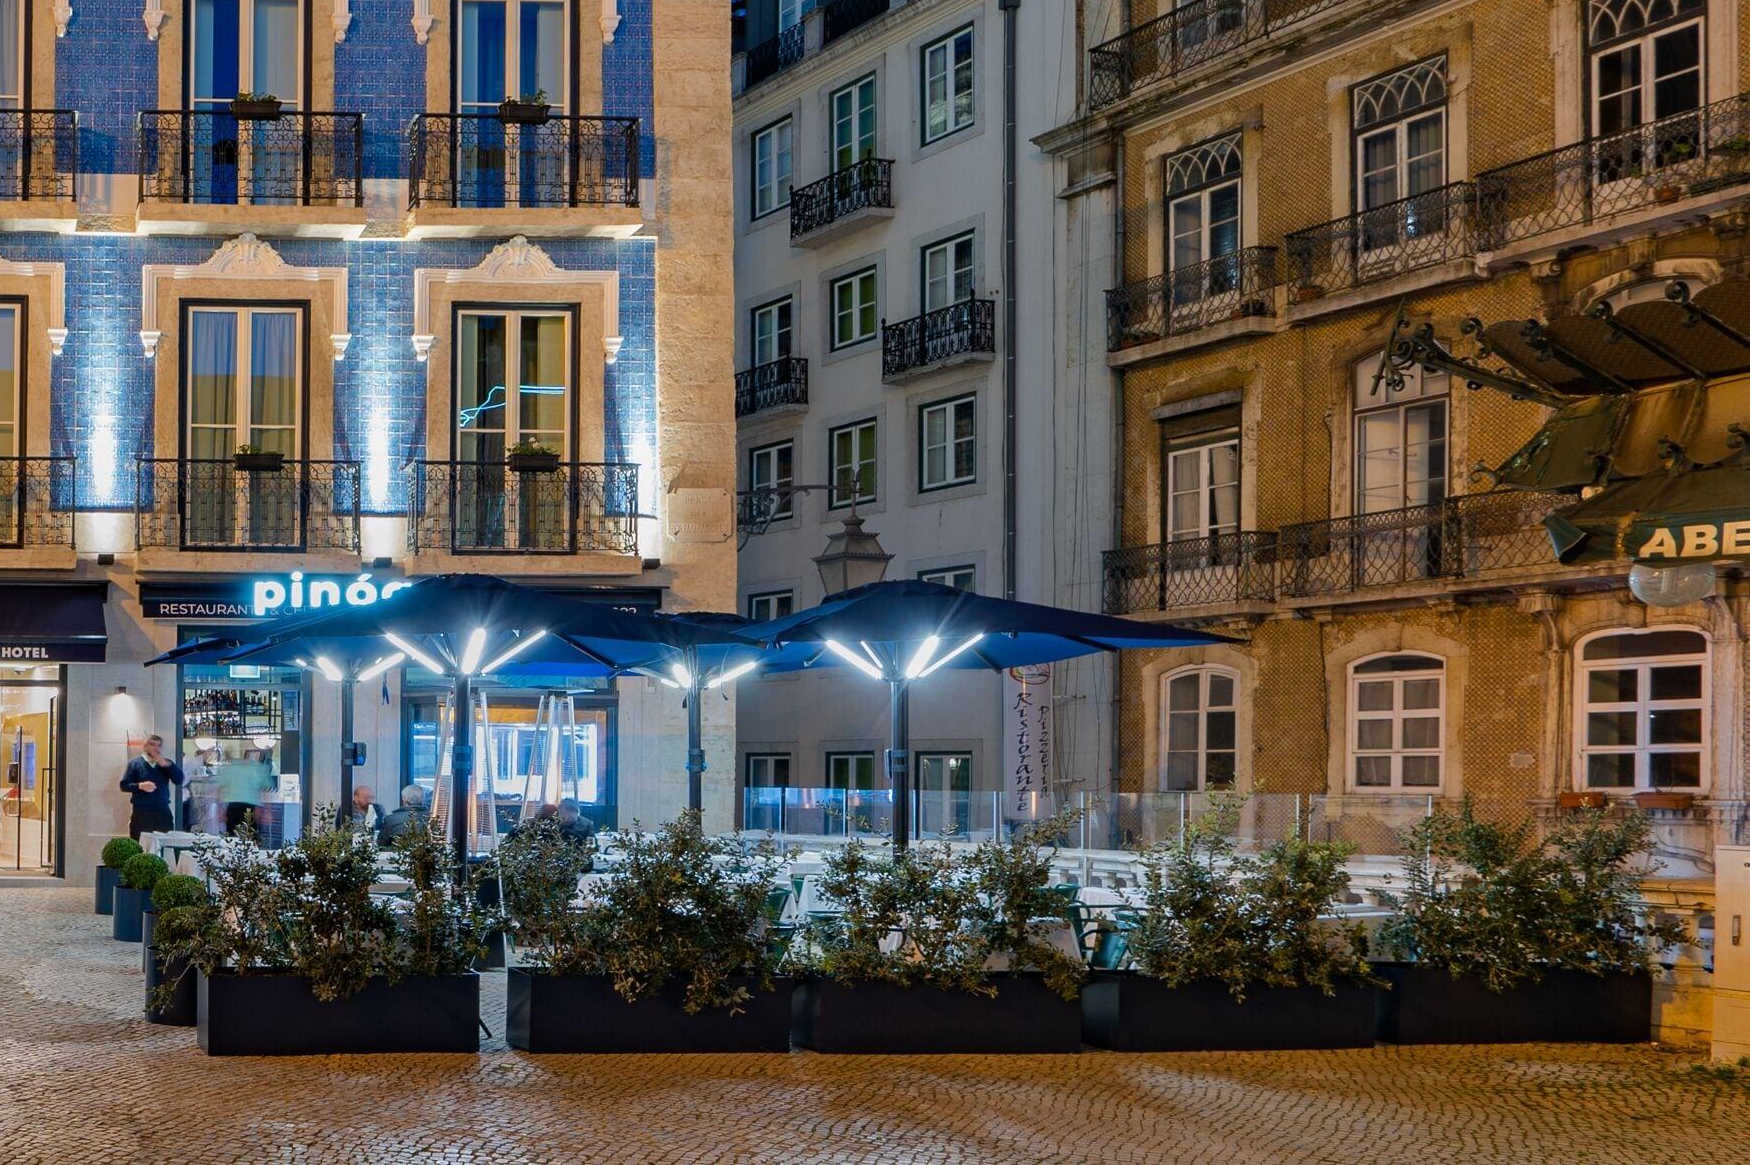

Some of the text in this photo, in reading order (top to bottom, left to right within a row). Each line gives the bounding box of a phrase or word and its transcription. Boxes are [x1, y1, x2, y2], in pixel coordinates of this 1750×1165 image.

[1639, 520, 1750, 558] ABE
[159, 603, 256, 616] RESTAURANT
[253, 571, 413, 616] pinó
[1, 647, 49, 658] HOTEL
[1013, 692, 1034, 812] Ristorante
[1037, 705, 1050, 799] Pizzeria
